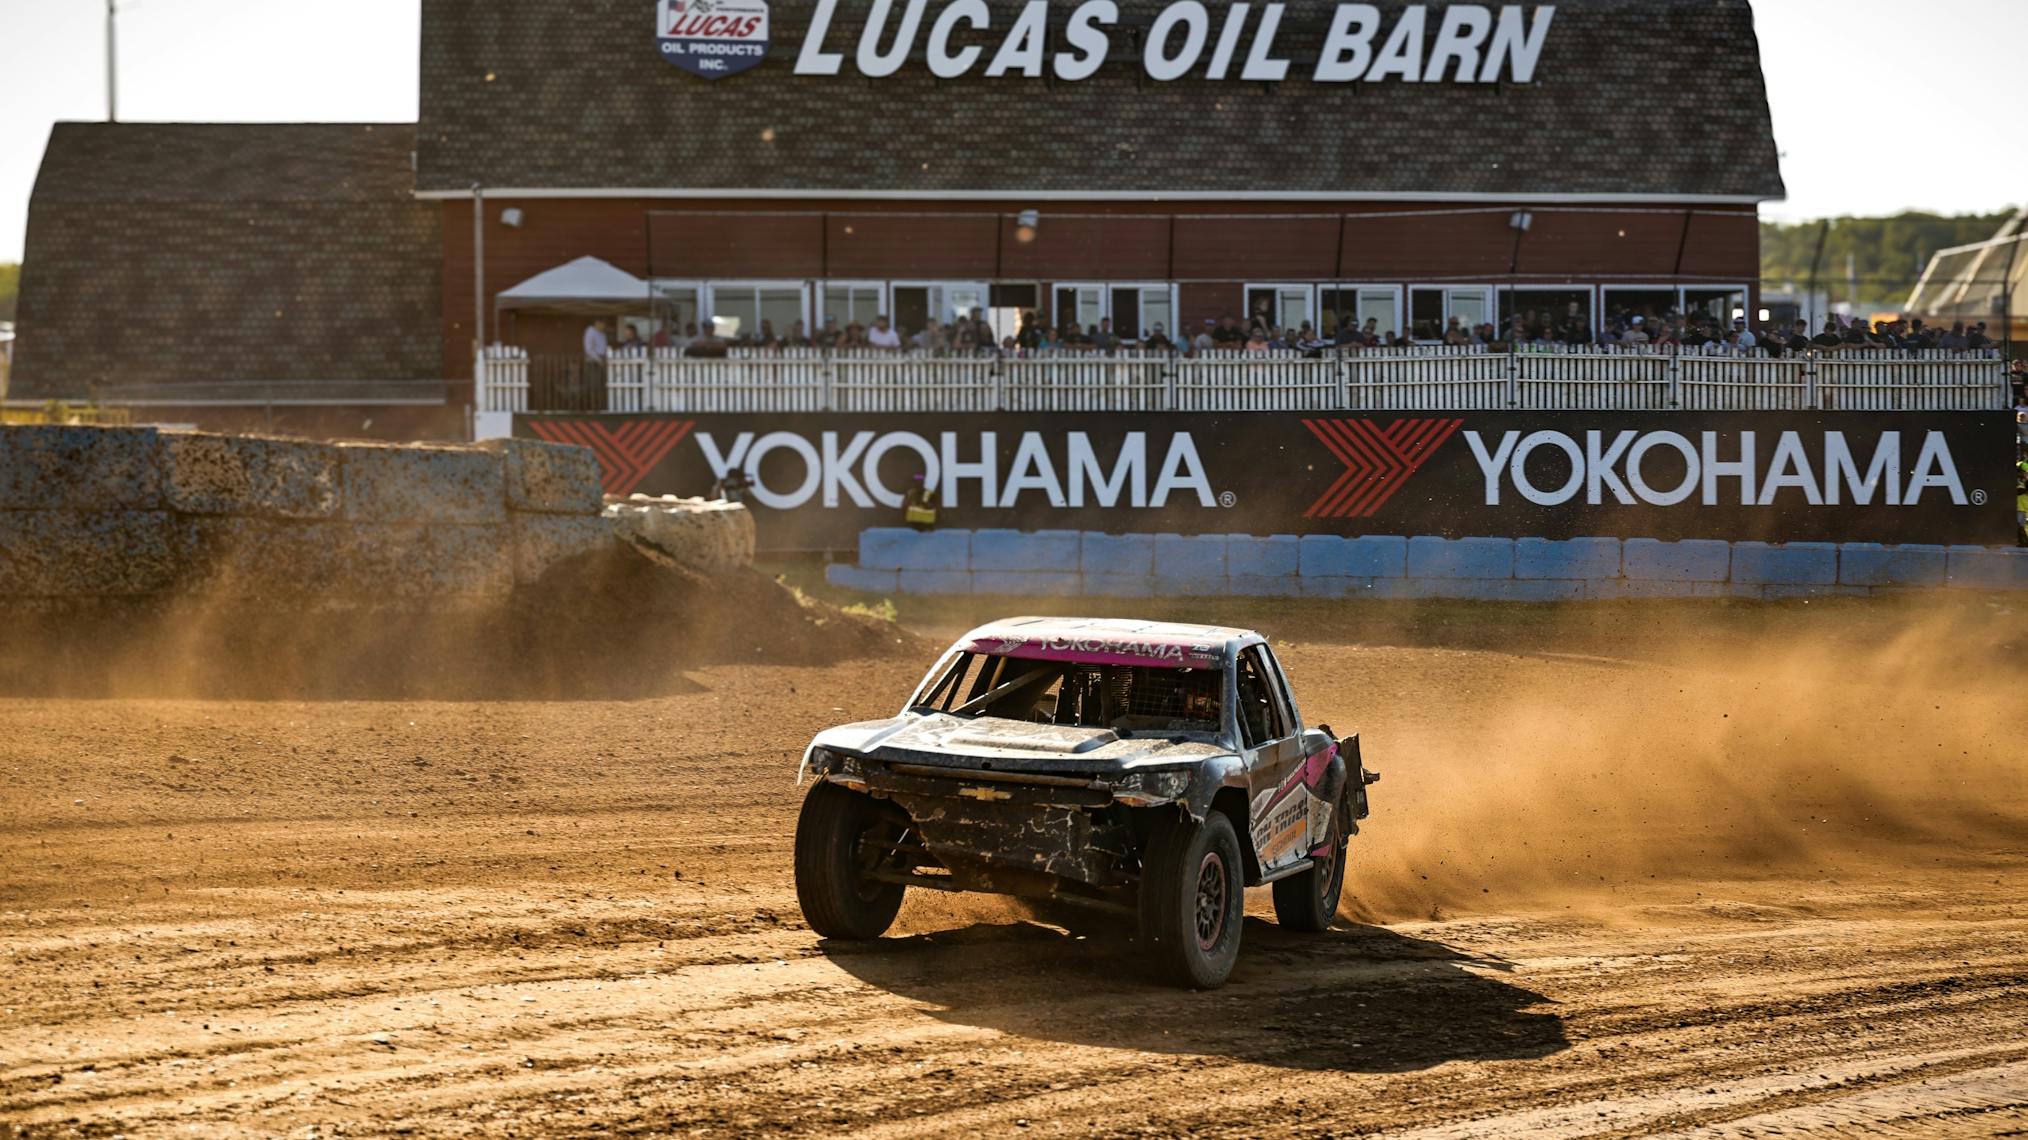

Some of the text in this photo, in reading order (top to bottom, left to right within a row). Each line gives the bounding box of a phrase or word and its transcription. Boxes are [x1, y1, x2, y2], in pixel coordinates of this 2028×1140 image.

[661, 42, 764, 56] OIL PRODUCTS
[667, 14, 763, 37] LUCAS
[794, 0, 1556, 83] LUCAS OIL BARN
[694, 431, 1217, 509] YOKOHAMA
[1463, 430, 1968, 506] YOKOHAMA
